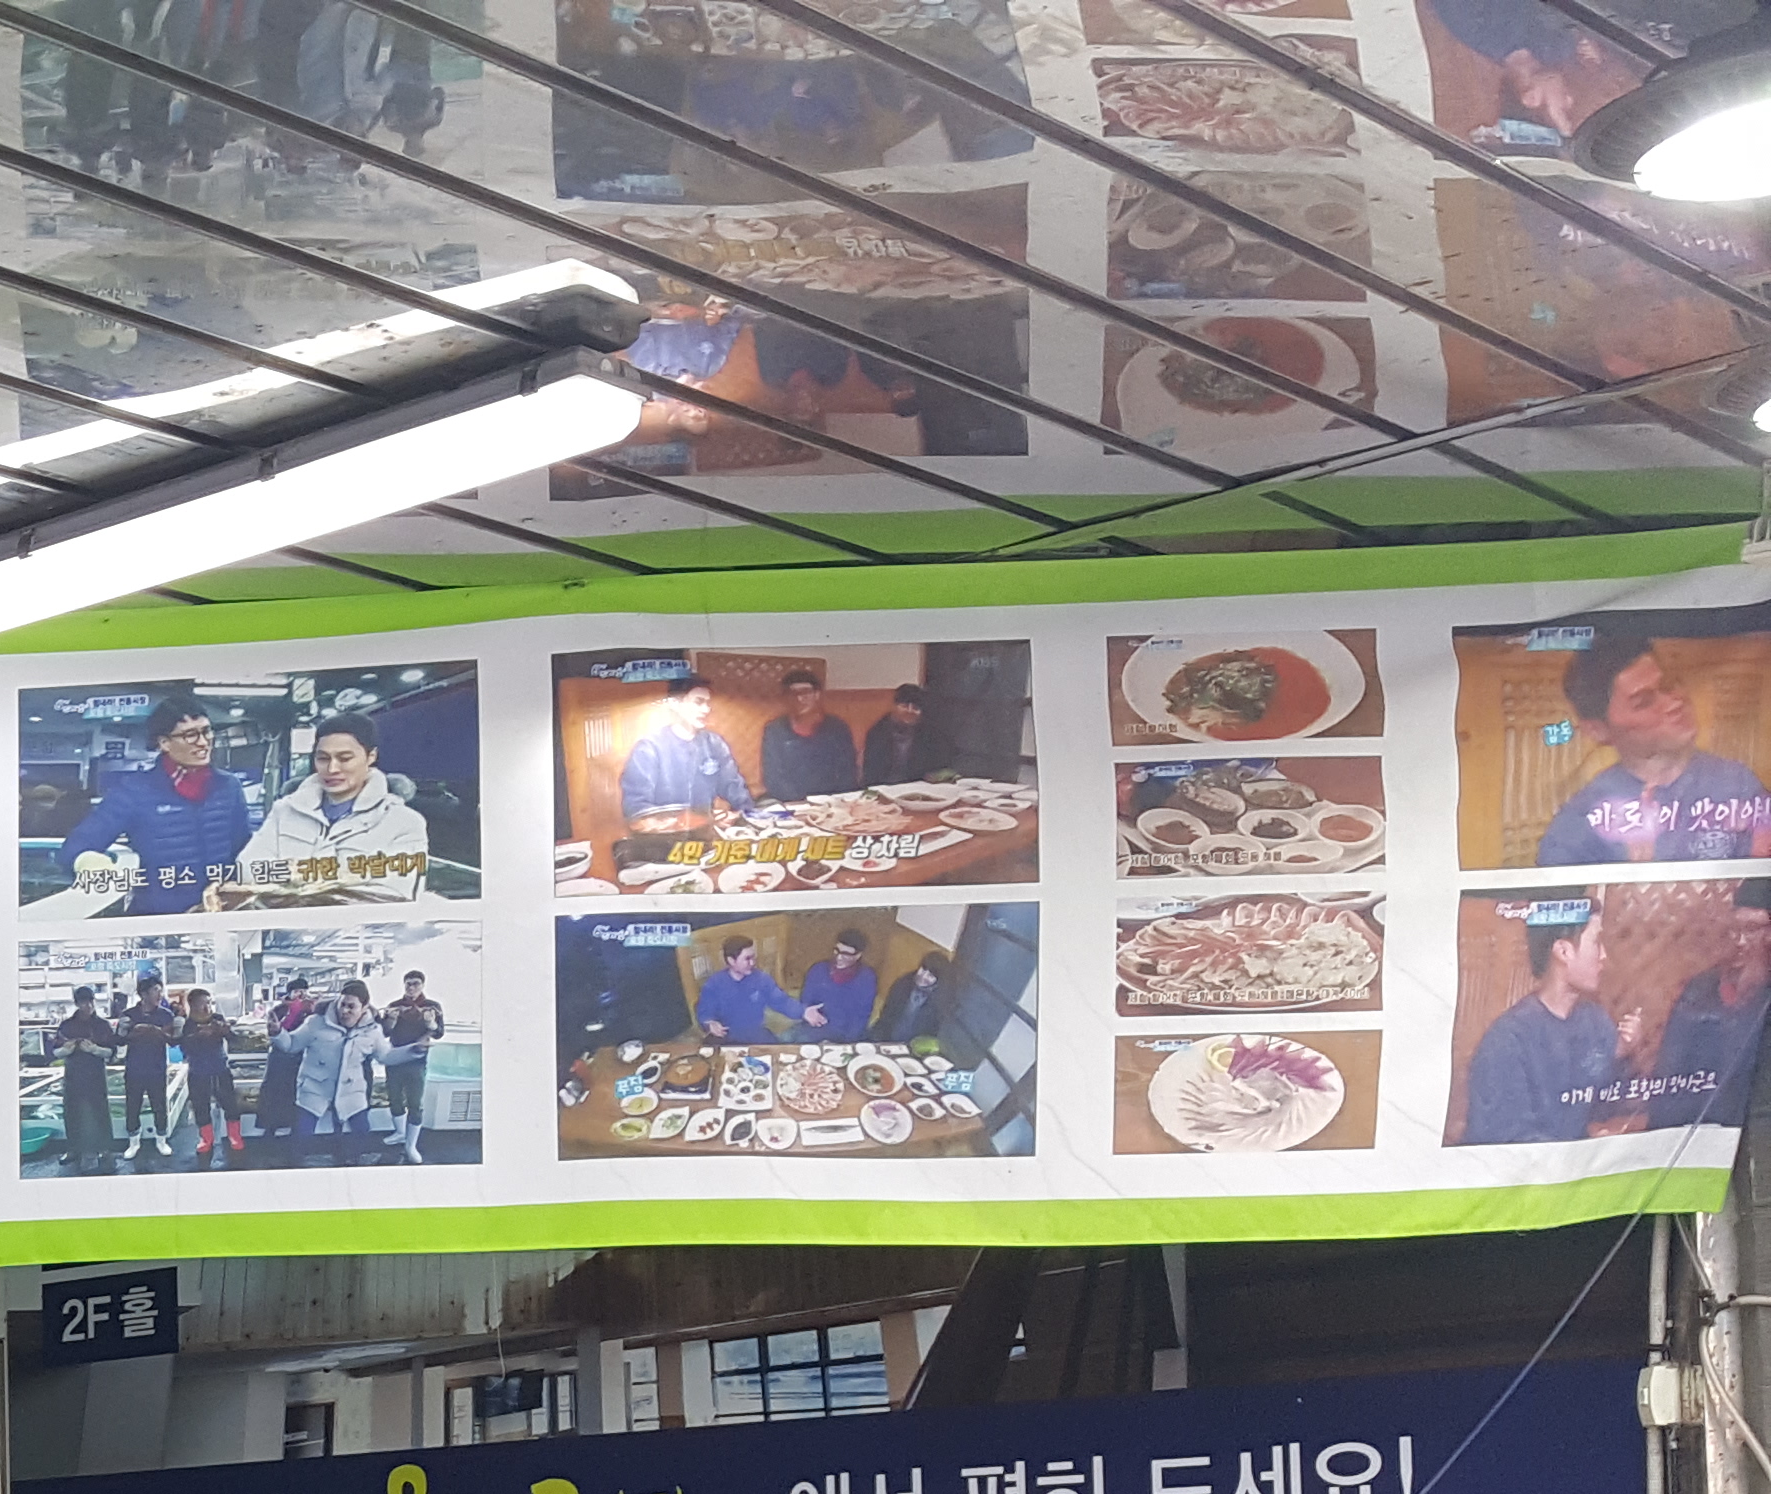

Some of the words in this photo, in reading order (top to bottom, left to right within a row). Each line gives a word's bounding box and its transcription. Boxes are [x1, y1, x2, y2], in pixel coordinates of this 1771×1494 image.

[1586, 800, 1644, 832] 바로
[1659, 801, 1680, 831] 이
[667, 840, 700, 866] 4인
[72, 862, 149, 894] 사장님도
[157, 861, 198, 890] 평소
[206, 858, 243, 888] 먹기
[251, 857, 291, 885] 힘든
[298, 855, 339, 881] 귀한
[348, 852, 427, 879] 박달대게
[62, 1297, 111, 1343] 2F
[118, 1286, 160, 1338] 홀
